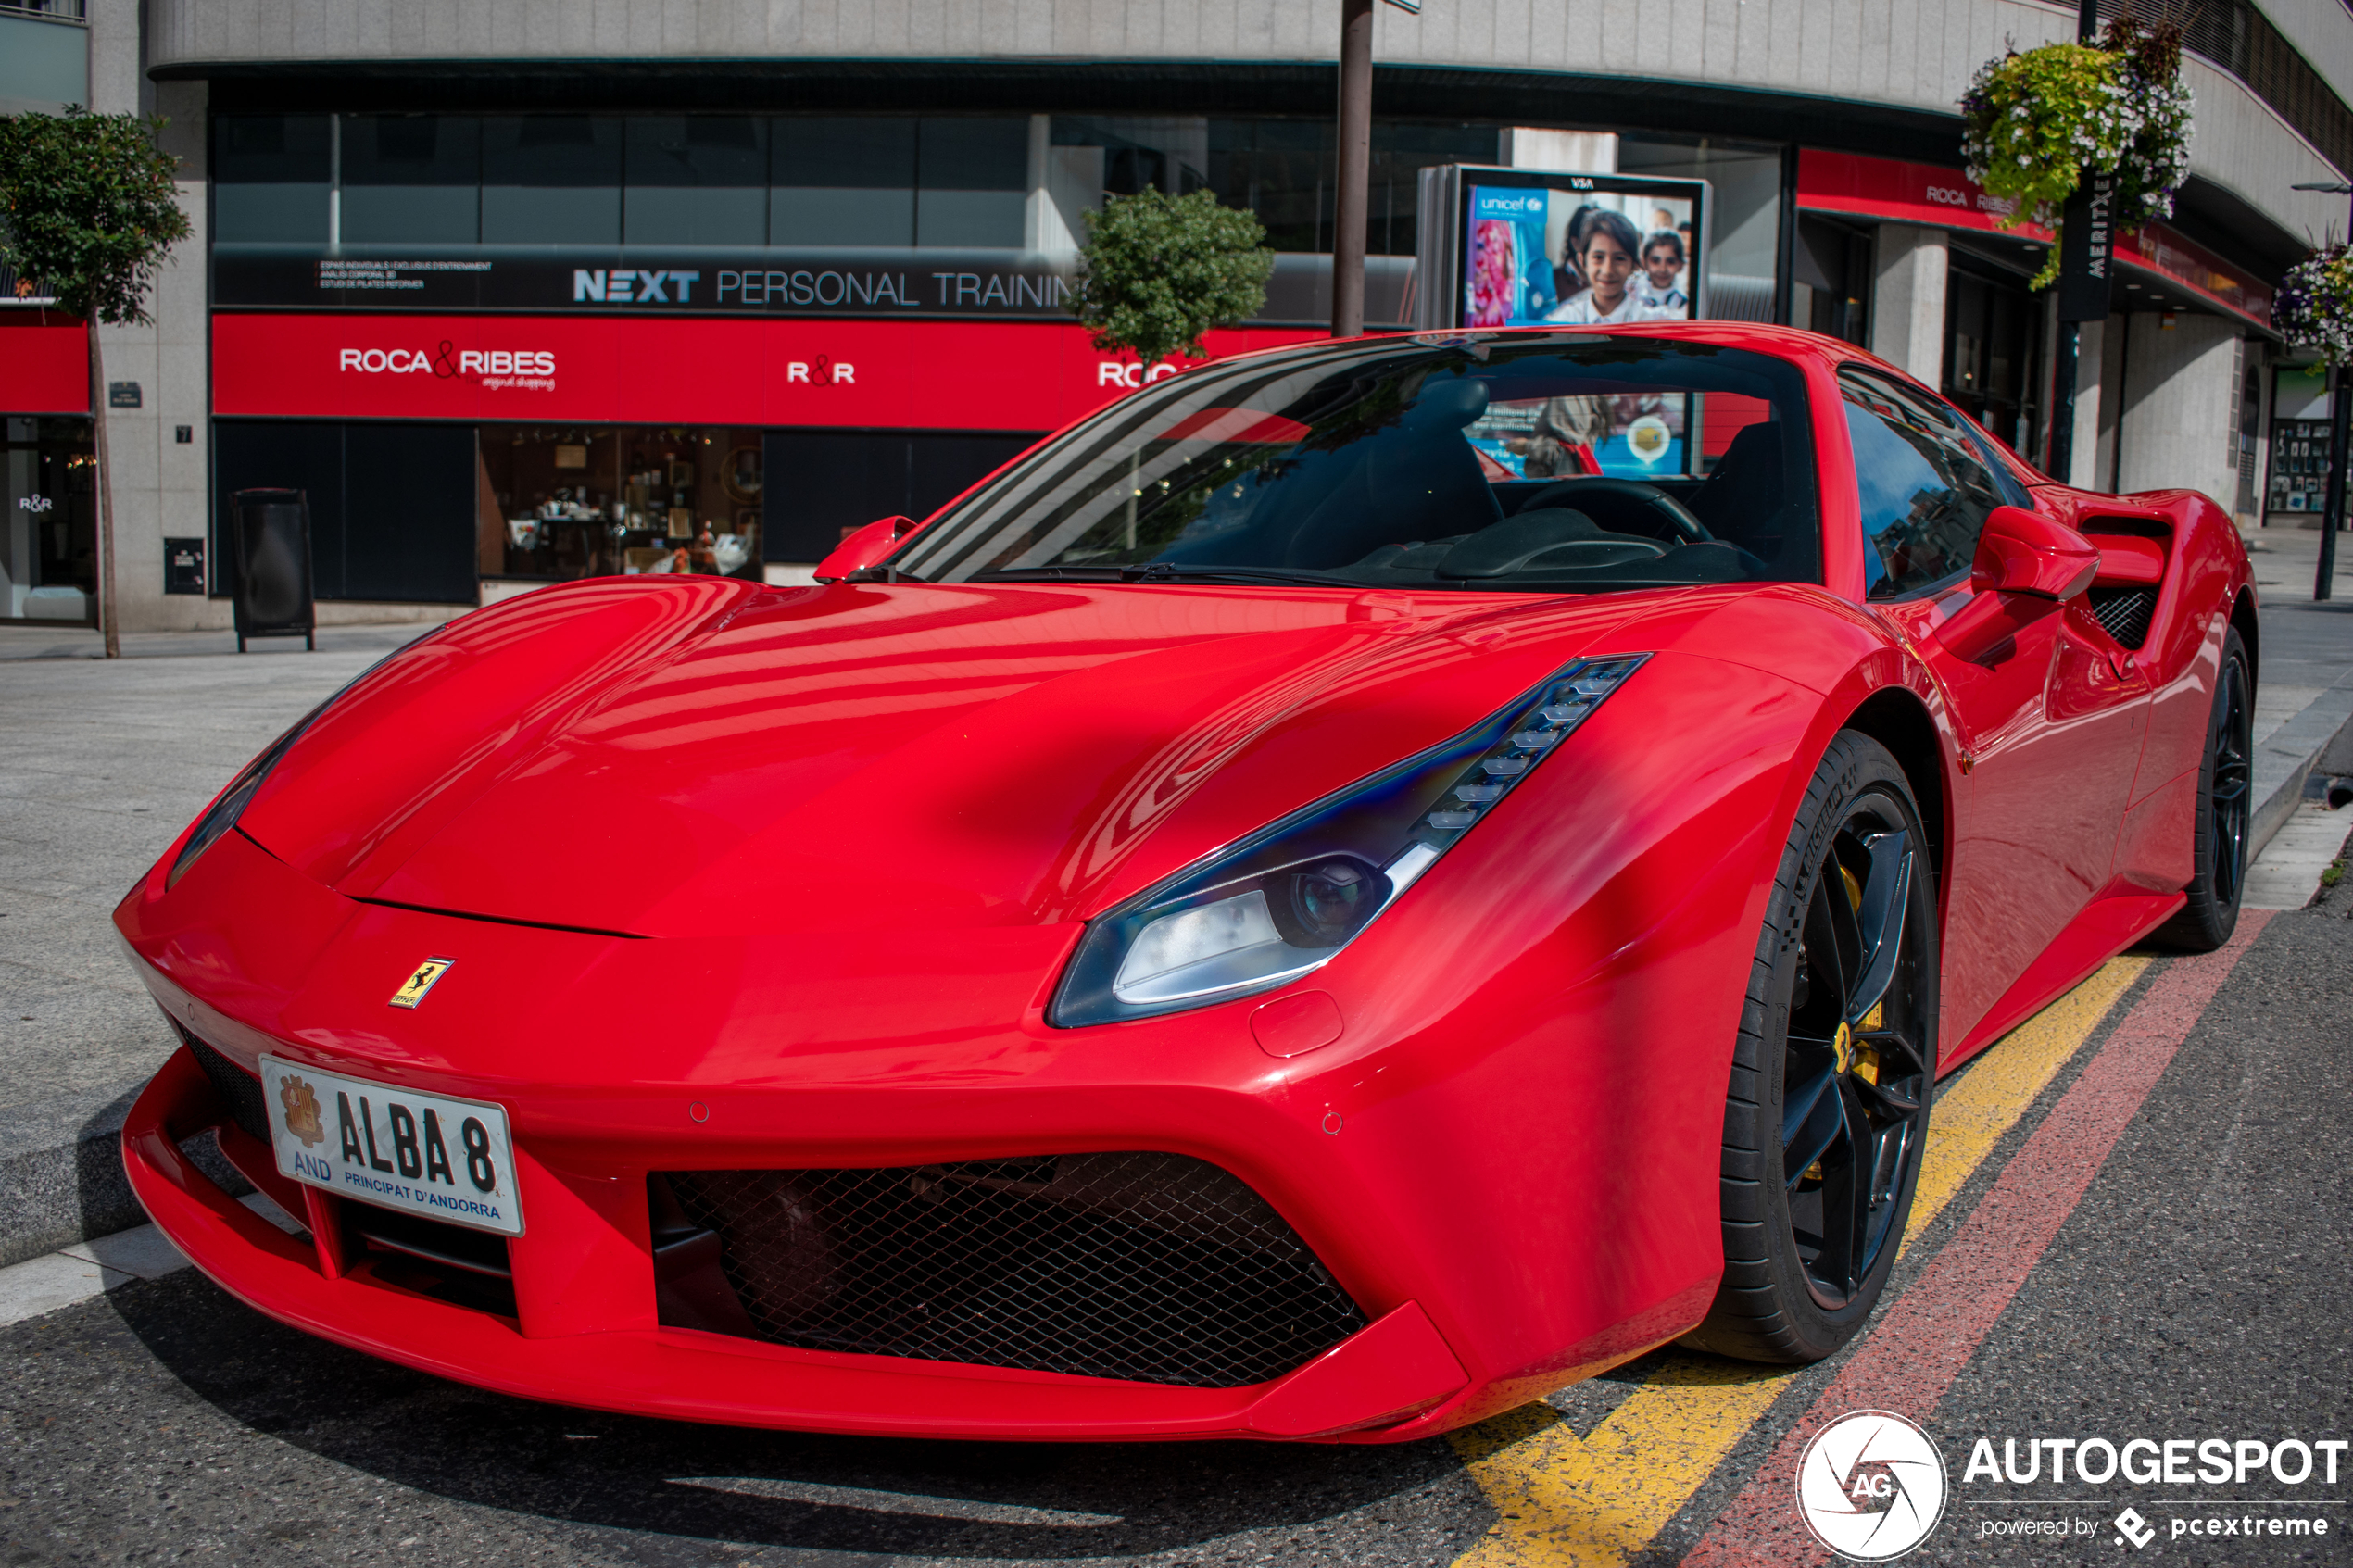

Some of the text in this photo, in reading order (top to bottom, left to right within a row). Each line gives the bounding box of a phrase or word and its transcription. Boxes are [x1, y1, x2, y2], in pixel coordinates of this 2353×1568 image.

[1481, 194, 1526, 211] unicef
[1926, 185, 2014, 214] ROCA RIBES
[347, 270, 385, 280] CORPORAL
[357, 280, 385, 289] PILATES
[573, 269, 700, 303] NEXT
[716, 270, 921, 305] PERSONAL
[19, 494, 53, 512] R&R
[1803, 782, 1843, 876] MICHELIN
[337, 1090, 497, 1192] ALBA 8
[294, 1151, 332, 1182] AND
[345, 1171, 501, 1220] PRINCIPAT D'ANDORRA
